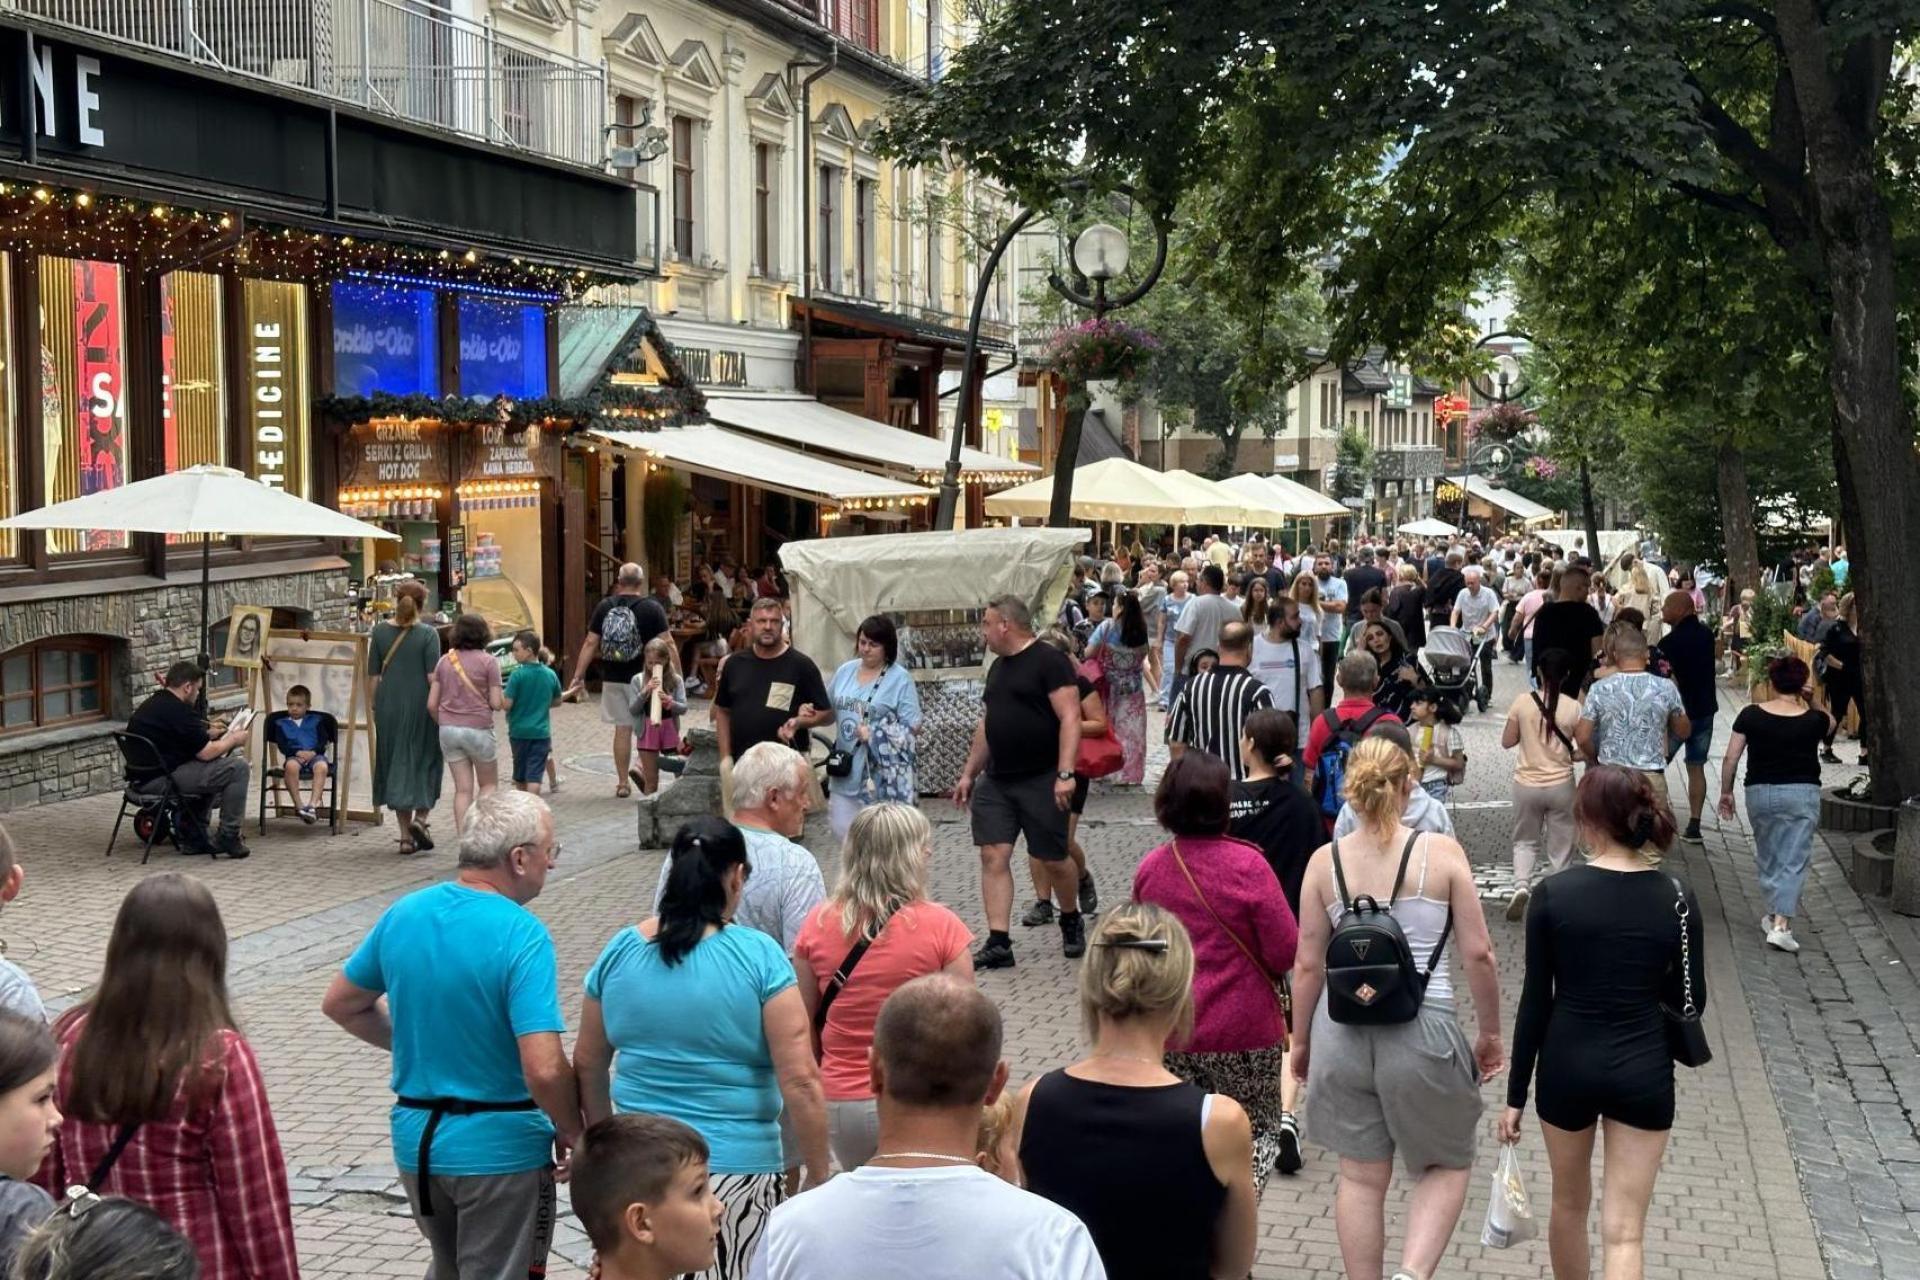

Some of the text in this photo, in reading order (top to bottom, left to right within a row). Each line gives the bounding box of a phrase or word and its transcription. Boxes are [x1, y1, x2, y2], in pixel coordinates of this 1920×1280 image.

[255, 322, 285, 492] MEDICINE
[376, 424, 421, 441] GRZANIEC
[365, 444, 432, 461] SERKI Z GRILLA
[379, 462, 420, 480] HOT DOG
[483, 460, 535, 475] KAWA HERBATA
